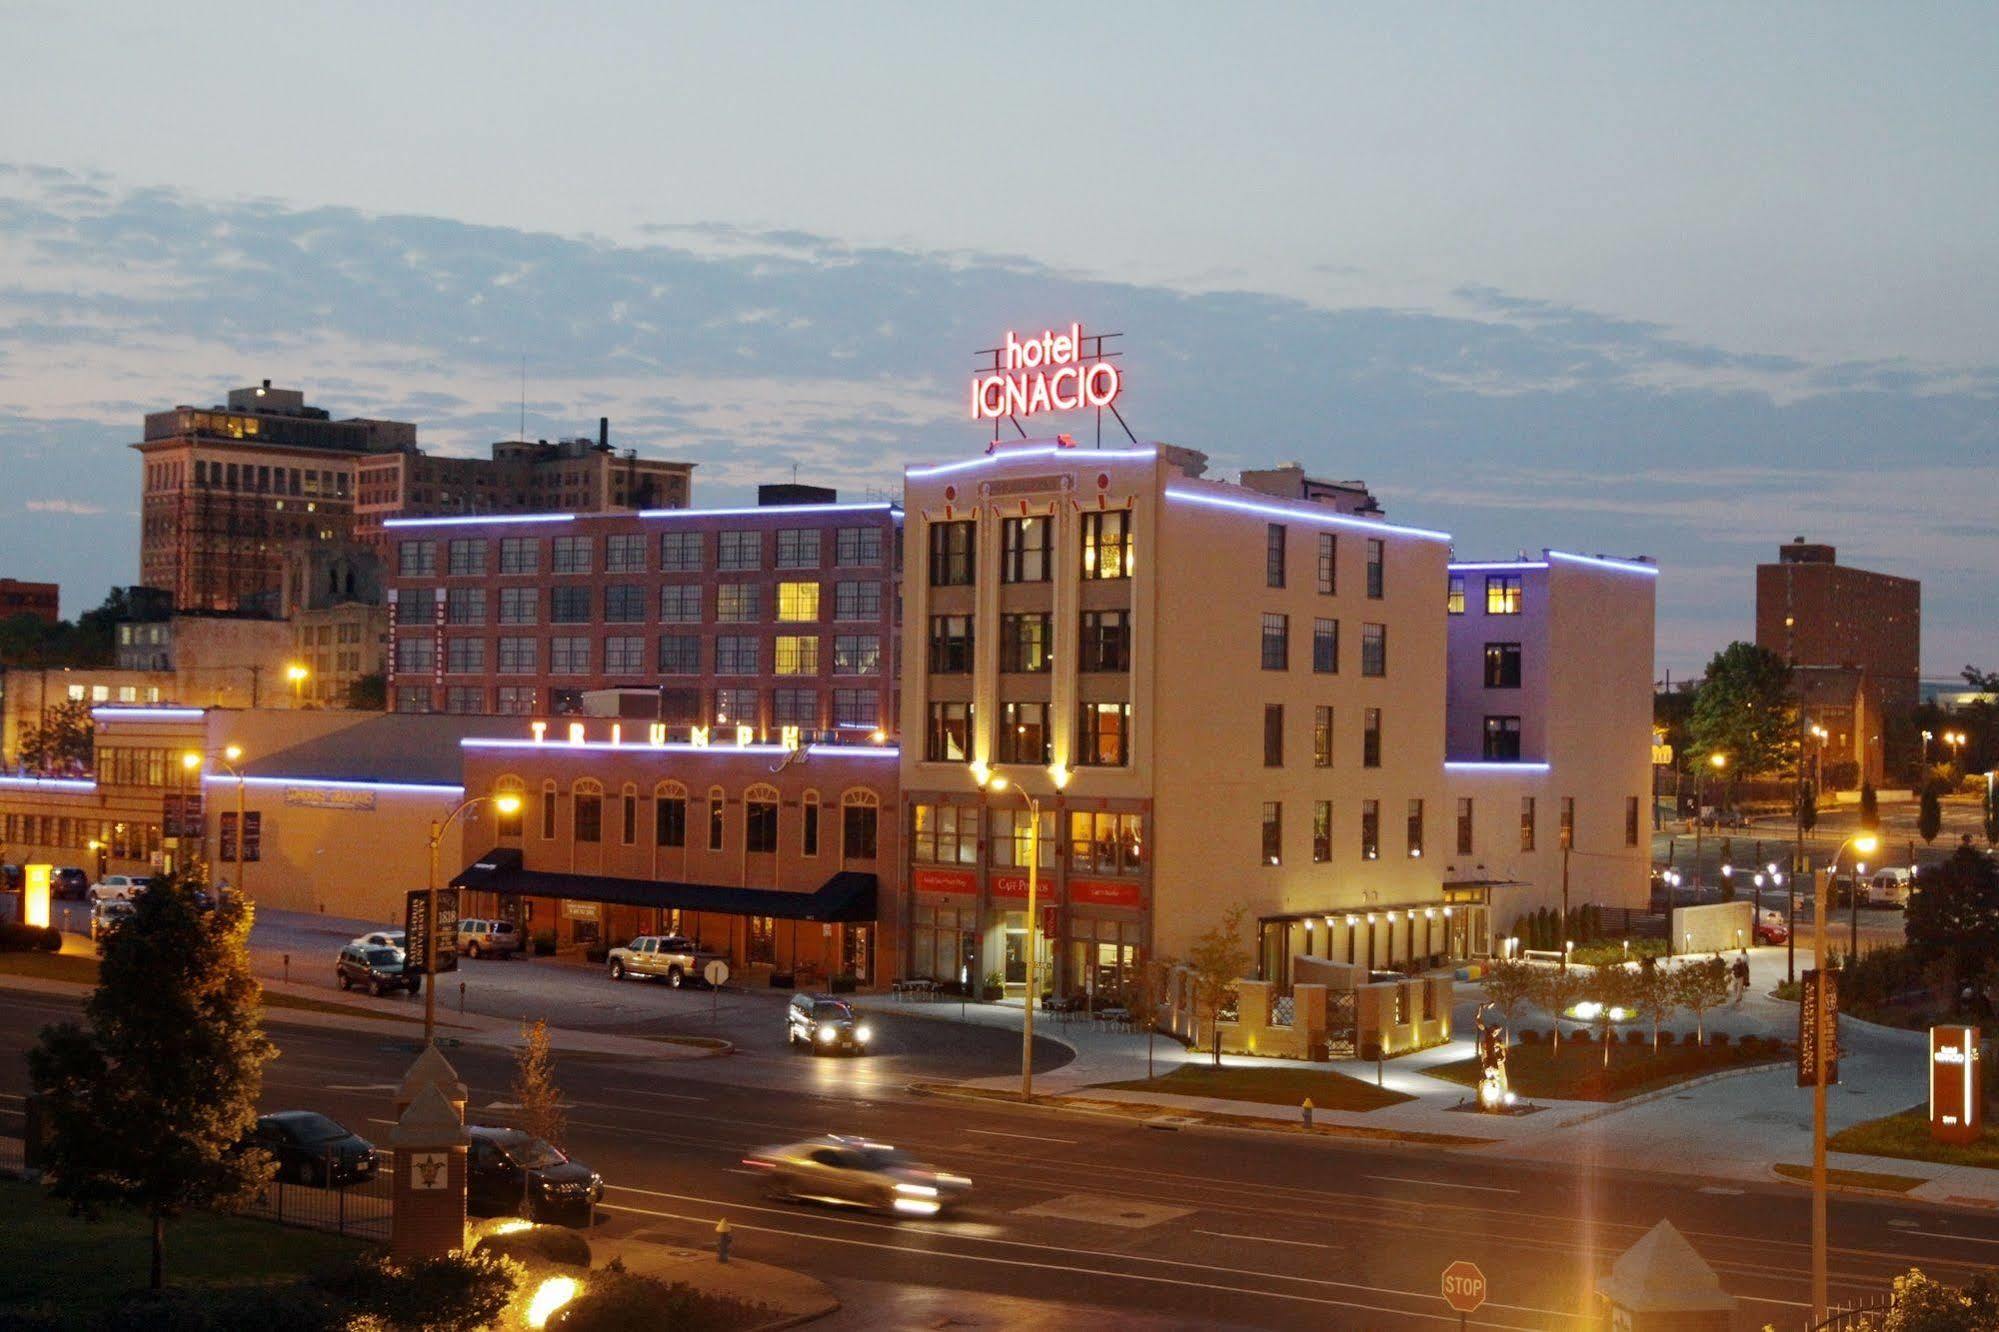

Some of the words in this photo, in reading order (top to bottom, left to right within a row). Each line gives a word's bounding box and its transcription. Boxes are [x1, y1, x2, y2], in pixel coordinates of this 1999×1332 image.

[1006, 322, 1081, 370] hotel
[971, 361, 1120, 419] IGNACIO
[531, 721, 800, 752] TRIUMPH
[438, 910, 457, 924] 1818
[408, 935, 417, 967] SAINT
[1445, 1276, 1482, 1296] STOP
